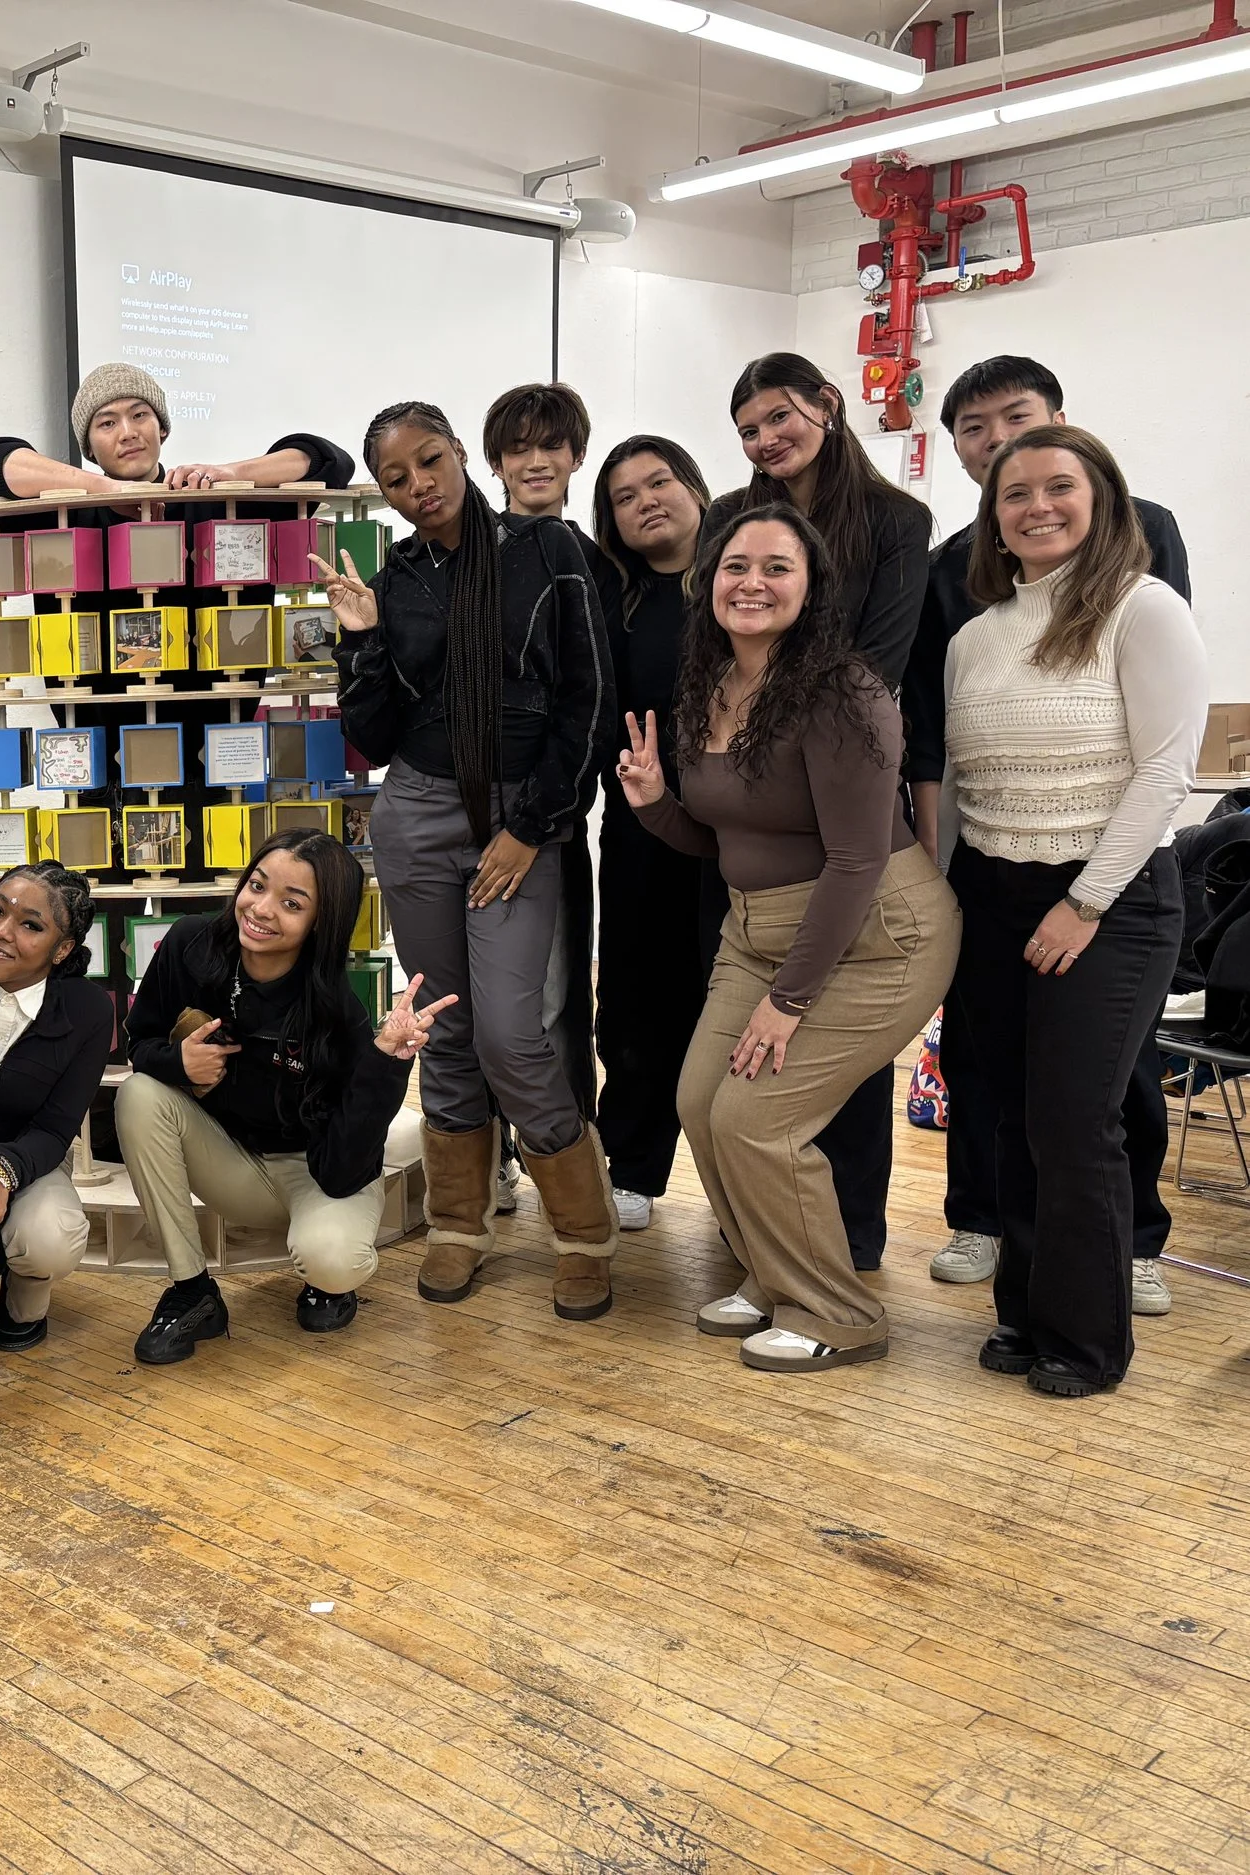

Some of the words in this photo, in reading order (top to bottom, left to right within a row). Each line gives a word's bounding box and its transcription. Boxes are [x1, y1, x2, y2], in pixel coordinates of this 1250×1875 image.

[149, 270, 192, 292] AirPlay
[121, 297, 153, 310] Wirelessly
[154, 301, 169, 310] send
[198, 306, 210, 316] your
[211, 308, 222, 317] iOS
[223, 309, 241, 319] device
[121, 311, 151, 323] computer
[159, 314, 170, 323] this
[171, 315, 193, 326] display
[193, 319, 209, 328] using
[231, 322, 248, 332] Learn
[122, 323, 138, 331] more
[122, 345, 163, 358] NETWORK
[165, 349, 229, 364] CONFIGURATION
[165, 389, 179, 400] HIS
[180, 390, 205, 402] APPLE
[205, 392, 216, 403] TV
[168, 405, 211, 420] U-311TV
[272, 1052, 305, 1071] DEAM
